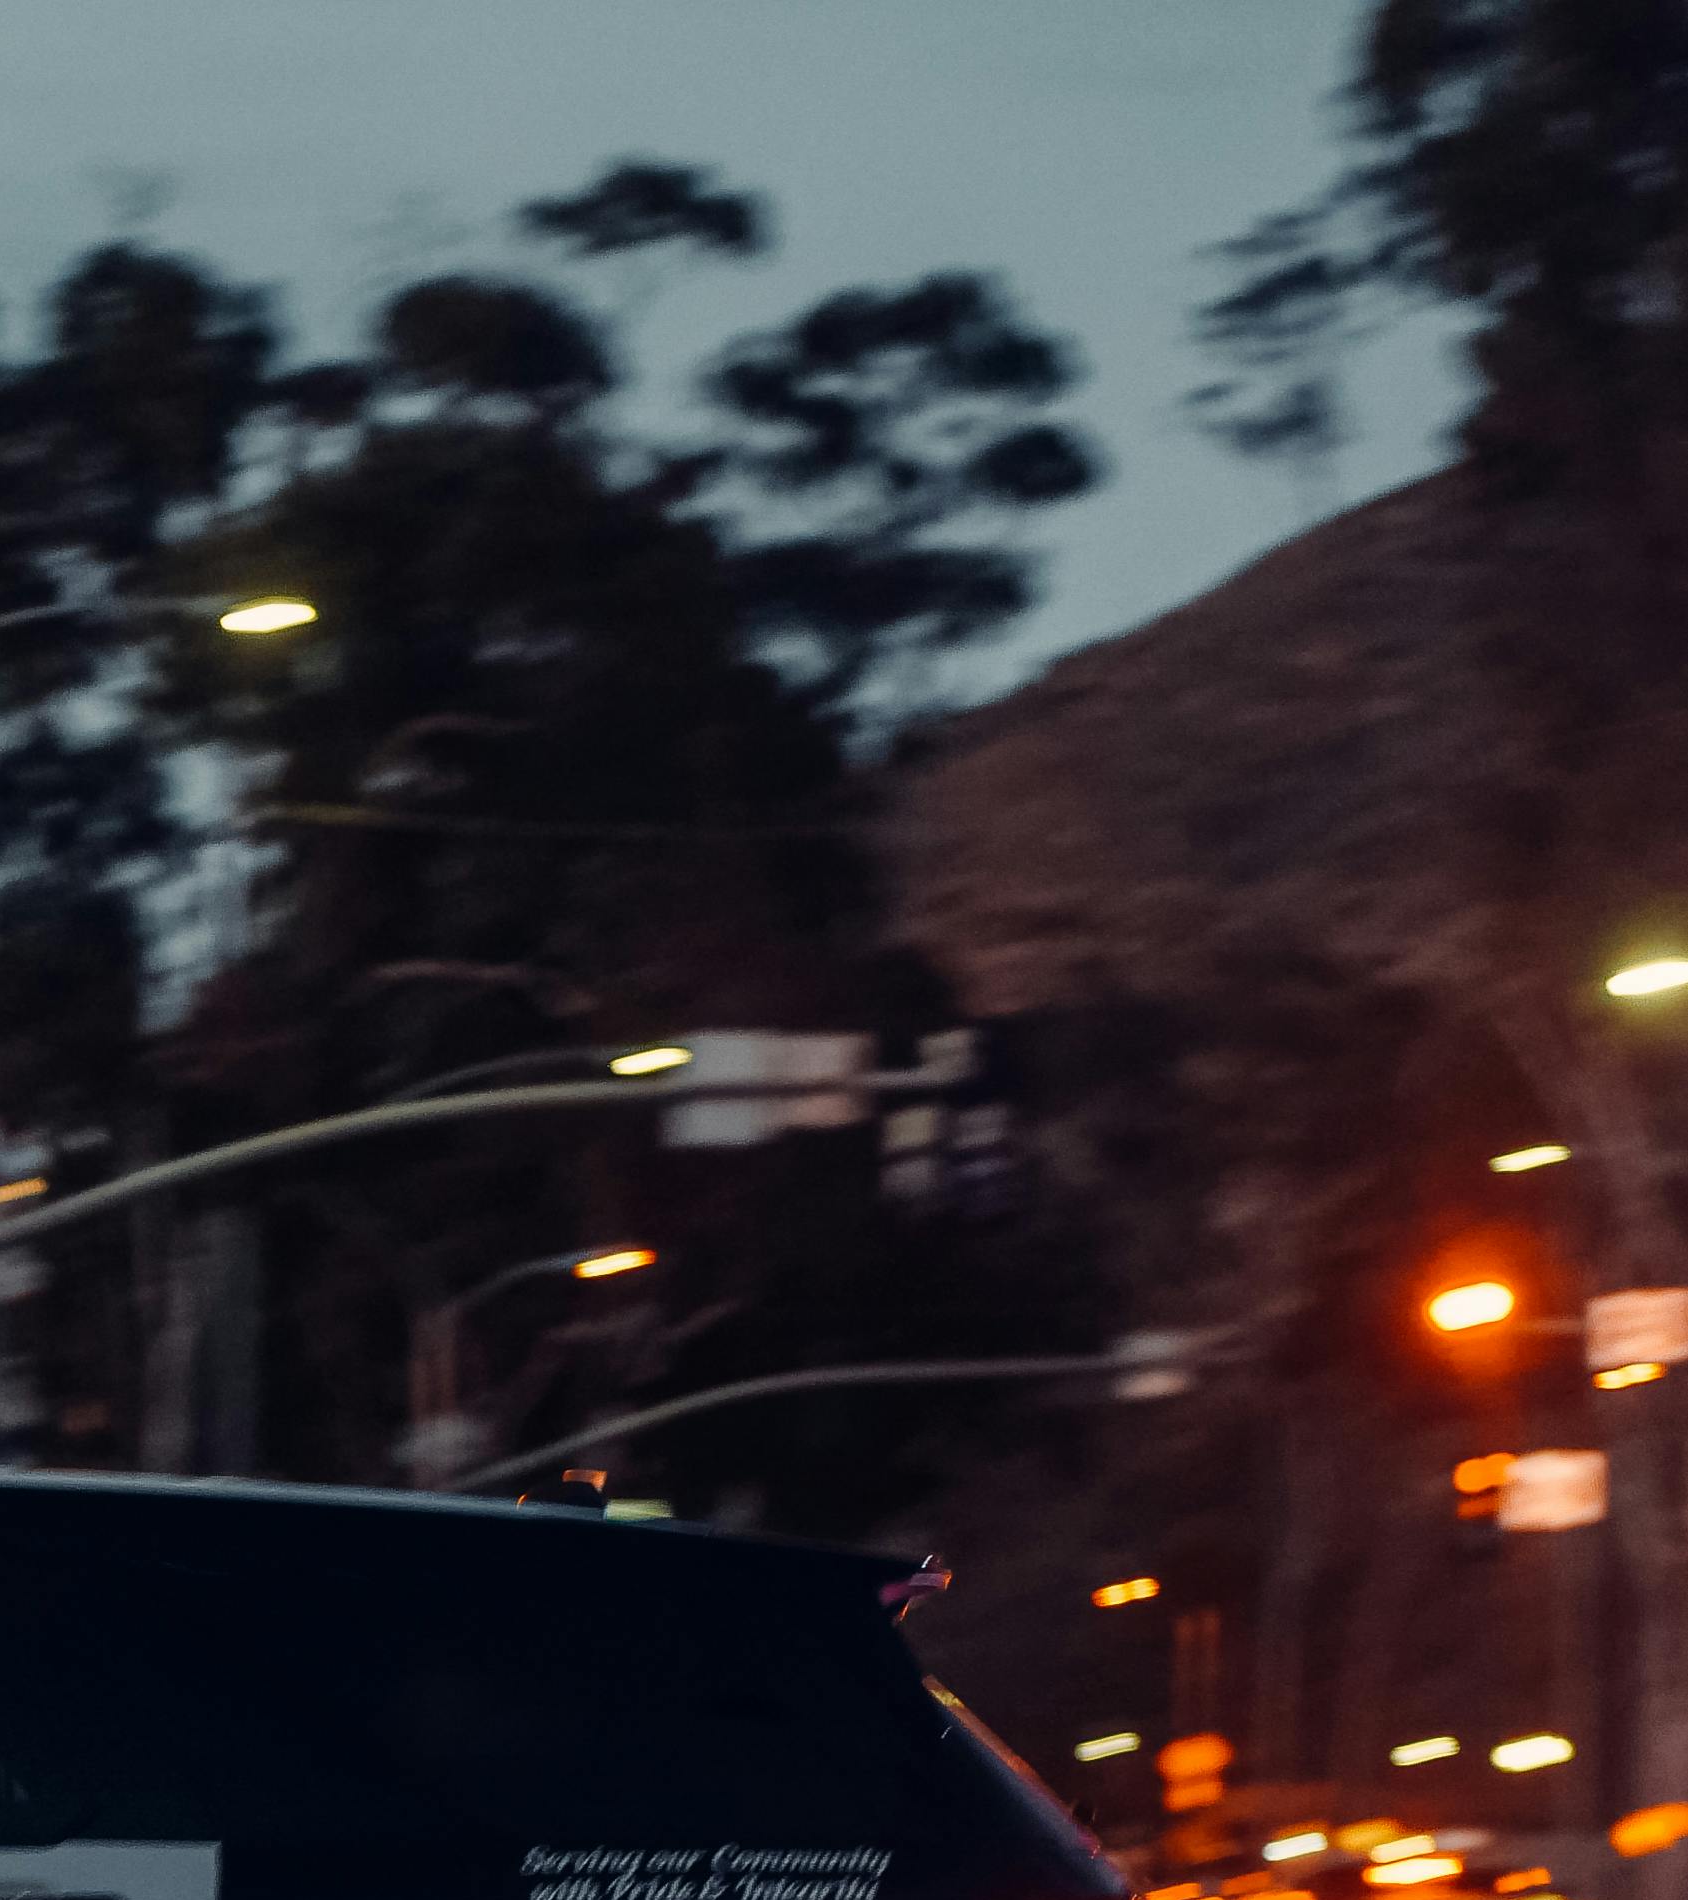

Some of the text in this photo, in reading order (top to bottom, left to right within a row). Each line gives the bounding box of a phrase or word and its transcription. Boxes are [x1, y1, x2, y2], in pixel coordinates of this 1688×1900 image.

[521, 1841, 893, 1879] Serving our Community
